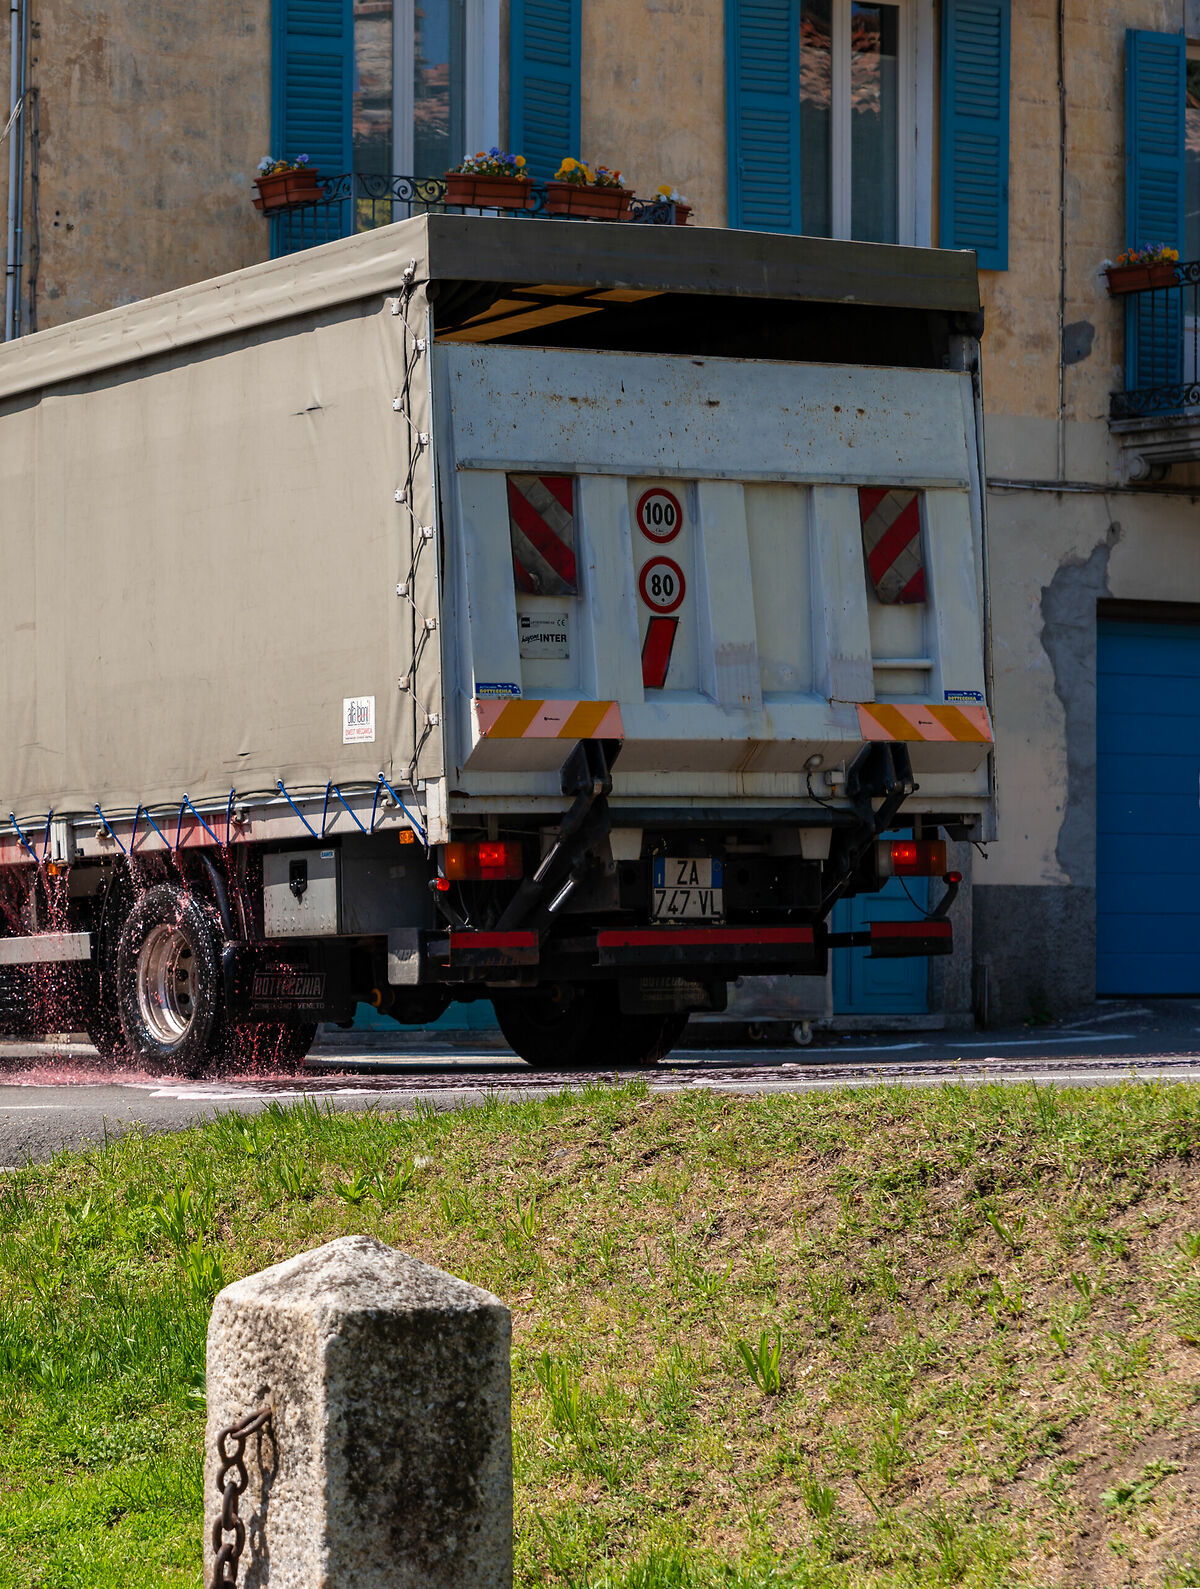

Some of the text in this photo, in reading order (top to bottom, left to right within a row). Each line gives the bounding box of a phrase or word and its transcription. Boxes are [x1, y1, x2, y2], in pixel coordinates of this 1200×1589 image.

[645, 502, 675, 526] 100
[651, 574, 674, 597] 80
[540, 633, 567, 643] INTER
[676, 860, 699, 885] ZA
[655, 889, 721, 915] 747 VL
